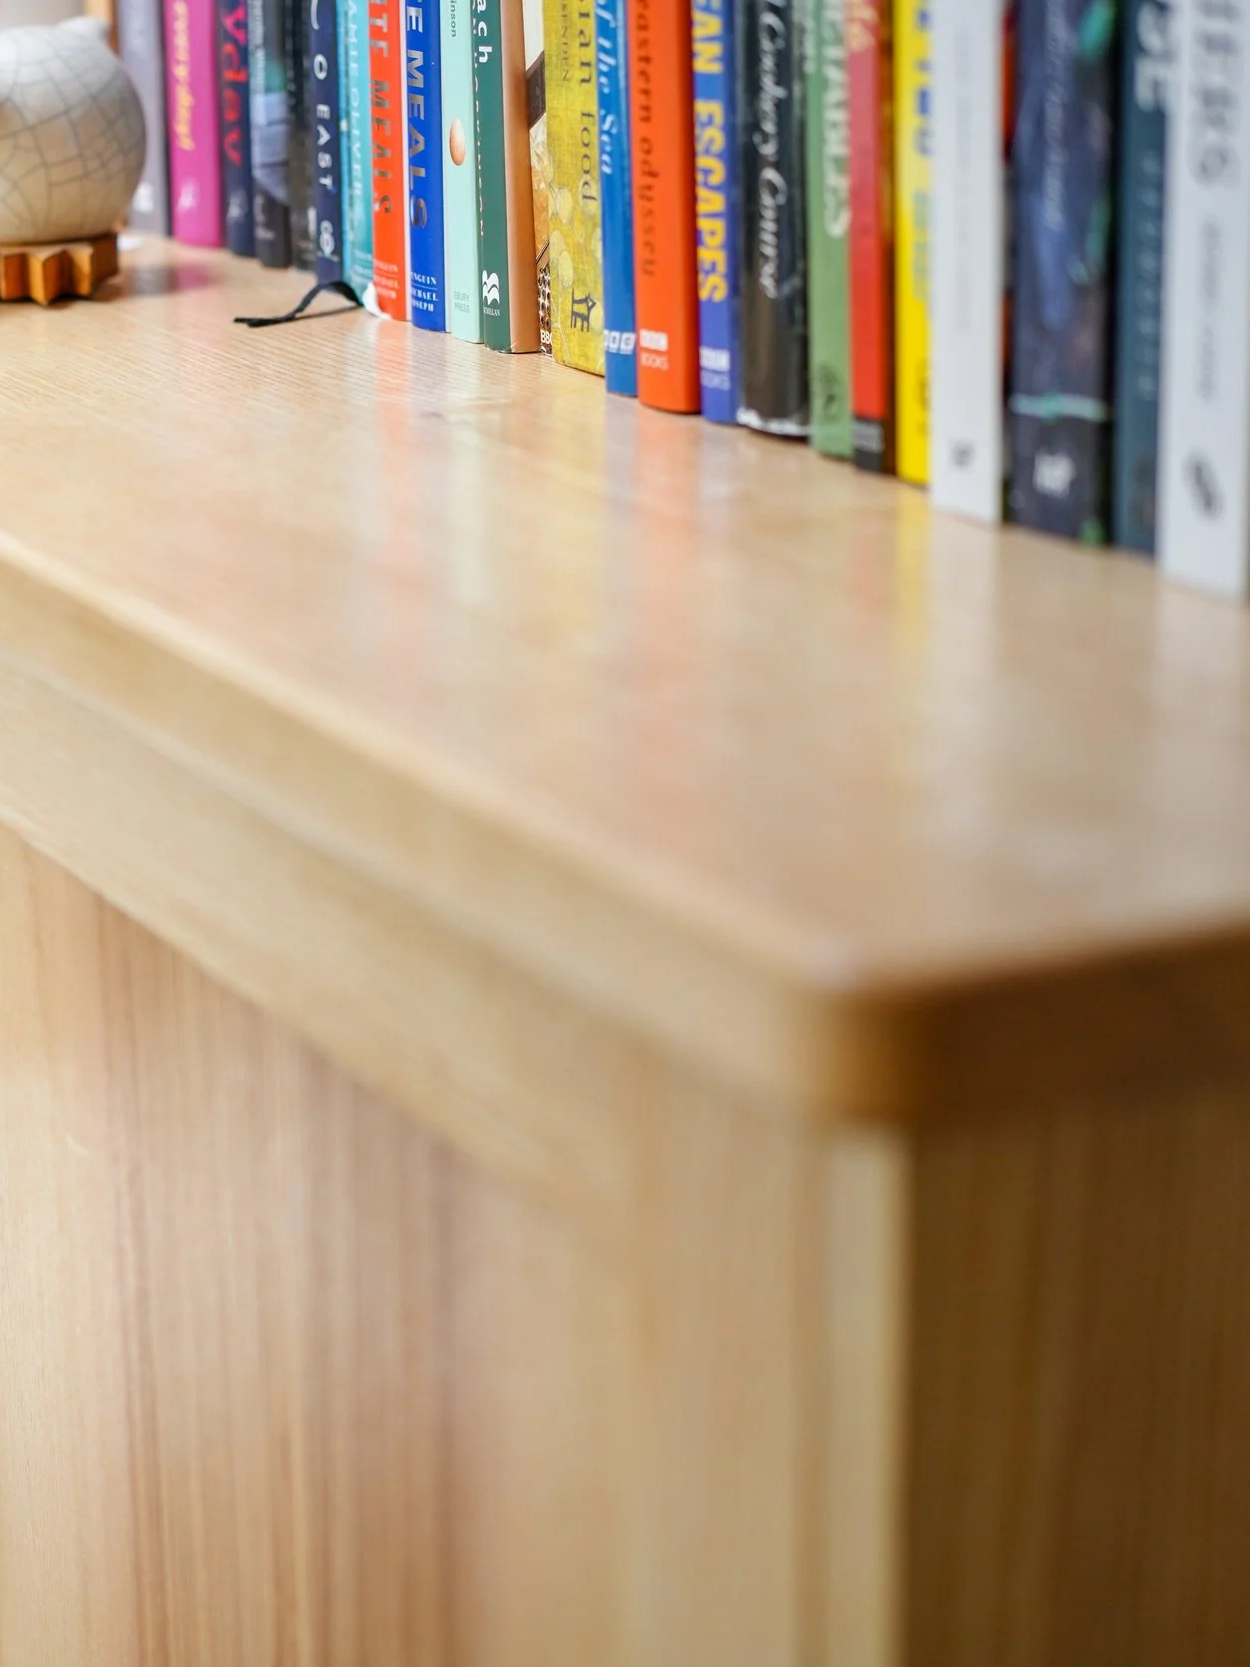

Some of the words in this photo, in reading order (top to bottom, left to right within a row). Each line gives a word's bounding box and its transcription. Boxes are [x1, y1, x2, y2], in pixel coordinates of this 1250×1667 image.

[370, 0, 388, 58] TE
[407, 0, 423, 33] E
[578, 0, 593, 84] ian
[597, 36, 617, 94] the
[222, 0, 248, 167] yday
[753, 11, 788, 158] Cookery
[822, 0, 851, 238] ETABLES
[316, 104, 333, 190] EAST
[351, 88, 362, 196] OLIVER
[407, 49, 427, 229] MEALS
[581, 111, 598, 202] food
[599, 108, 619, 175] Sea
[694, 98, 728, 303] ESCAPES
[759, 166, 788, 299] Course
